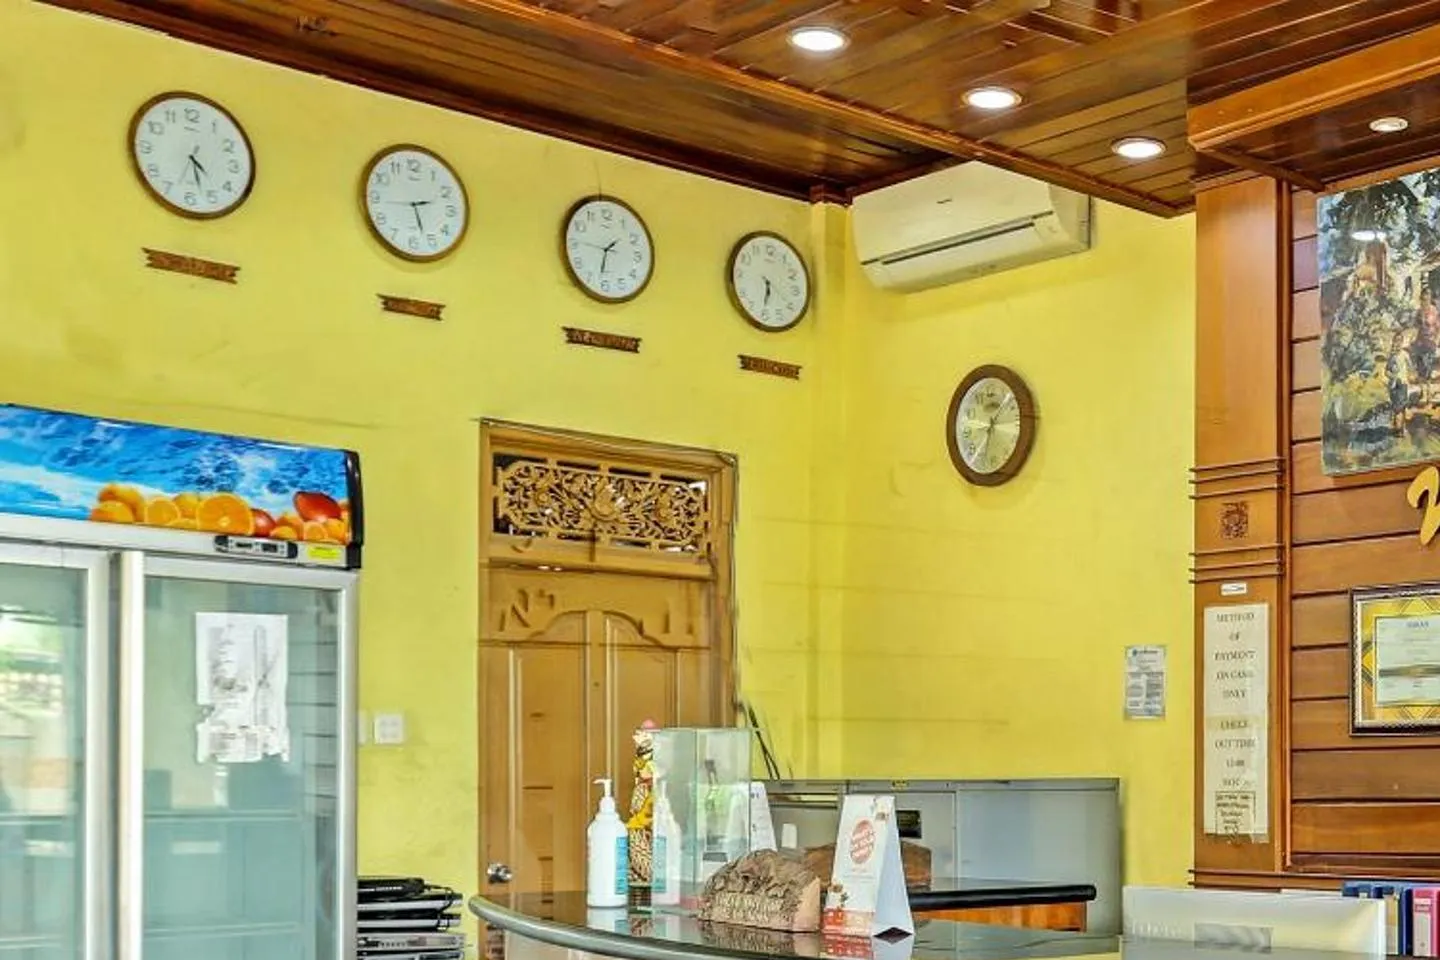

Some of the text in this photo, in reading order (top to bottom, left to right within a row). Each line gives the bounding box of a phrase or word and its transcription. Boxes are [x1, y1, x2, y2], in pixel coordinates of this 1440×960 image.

[165, 109, 176, 123] 11
[184, 108, 200, 123] 12
[148, 120, 165, 135] 10
[211, 120, 217, 133] 1
[222, 139, 234, 153] 2
[228, 159, 240, 173] 3
[407, 159, 421, 173] 12
[163, 181, 174, 194] 7
[222, 181, 233, 192] 4
[440, 186, 452, 198] 2
[184, 192, 197, 206] 6
[206, 190, 218, 204] 5
[445, 205, 456, 218] 3
